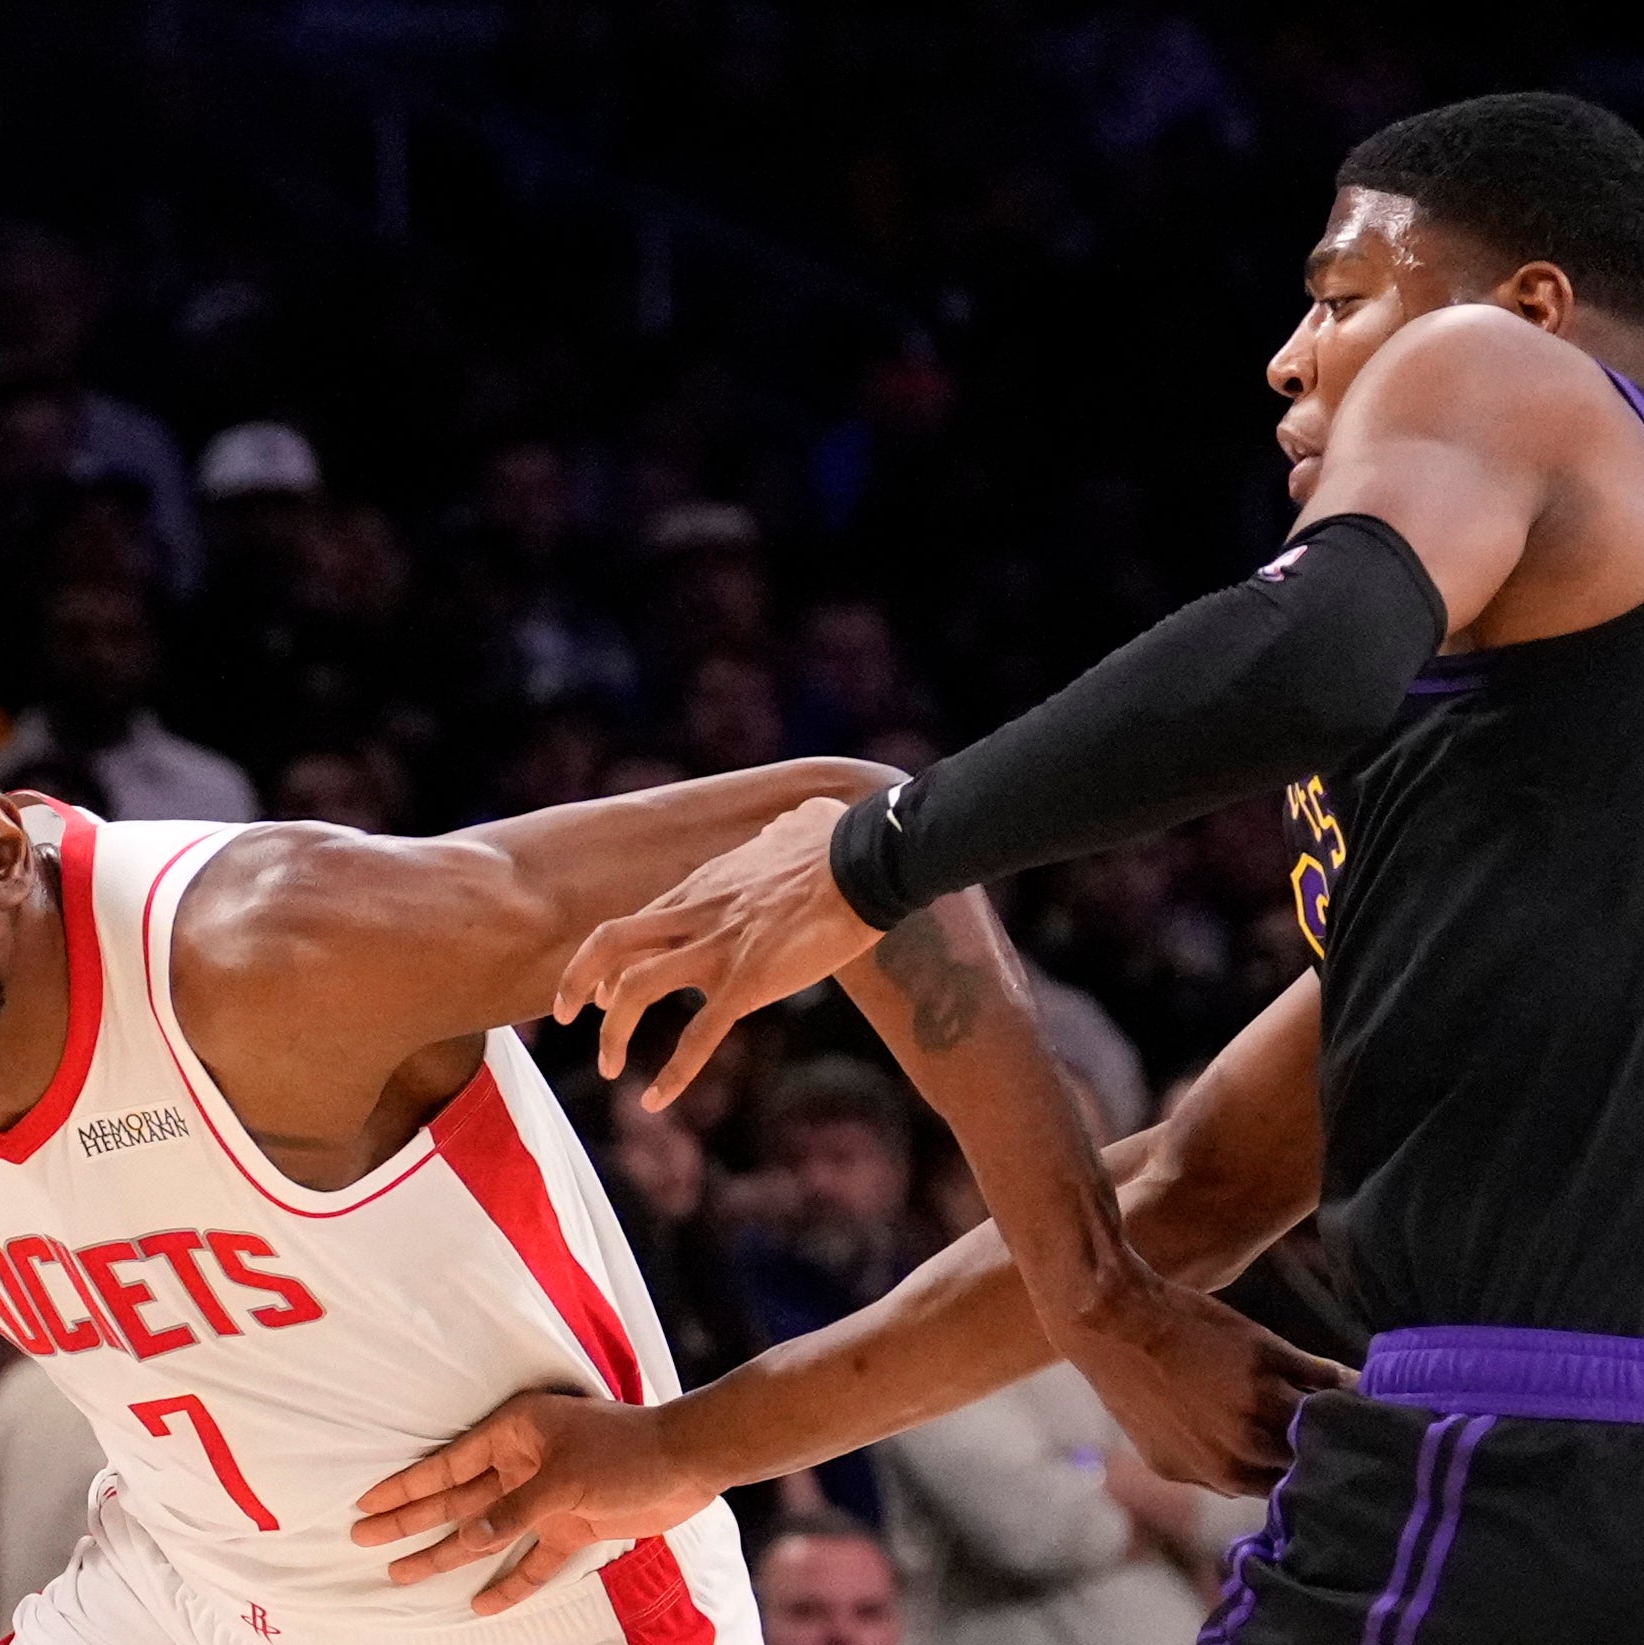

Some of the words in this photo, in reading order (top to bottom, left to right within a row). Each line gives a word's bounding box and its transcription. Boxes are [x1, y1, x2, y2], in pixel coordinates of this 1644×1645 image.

[77, 1106, 185, 1144] MEMORIAL
[81, 1119, 191, 1158] HERMANN
[127, 1394, 281, 1532] 7
